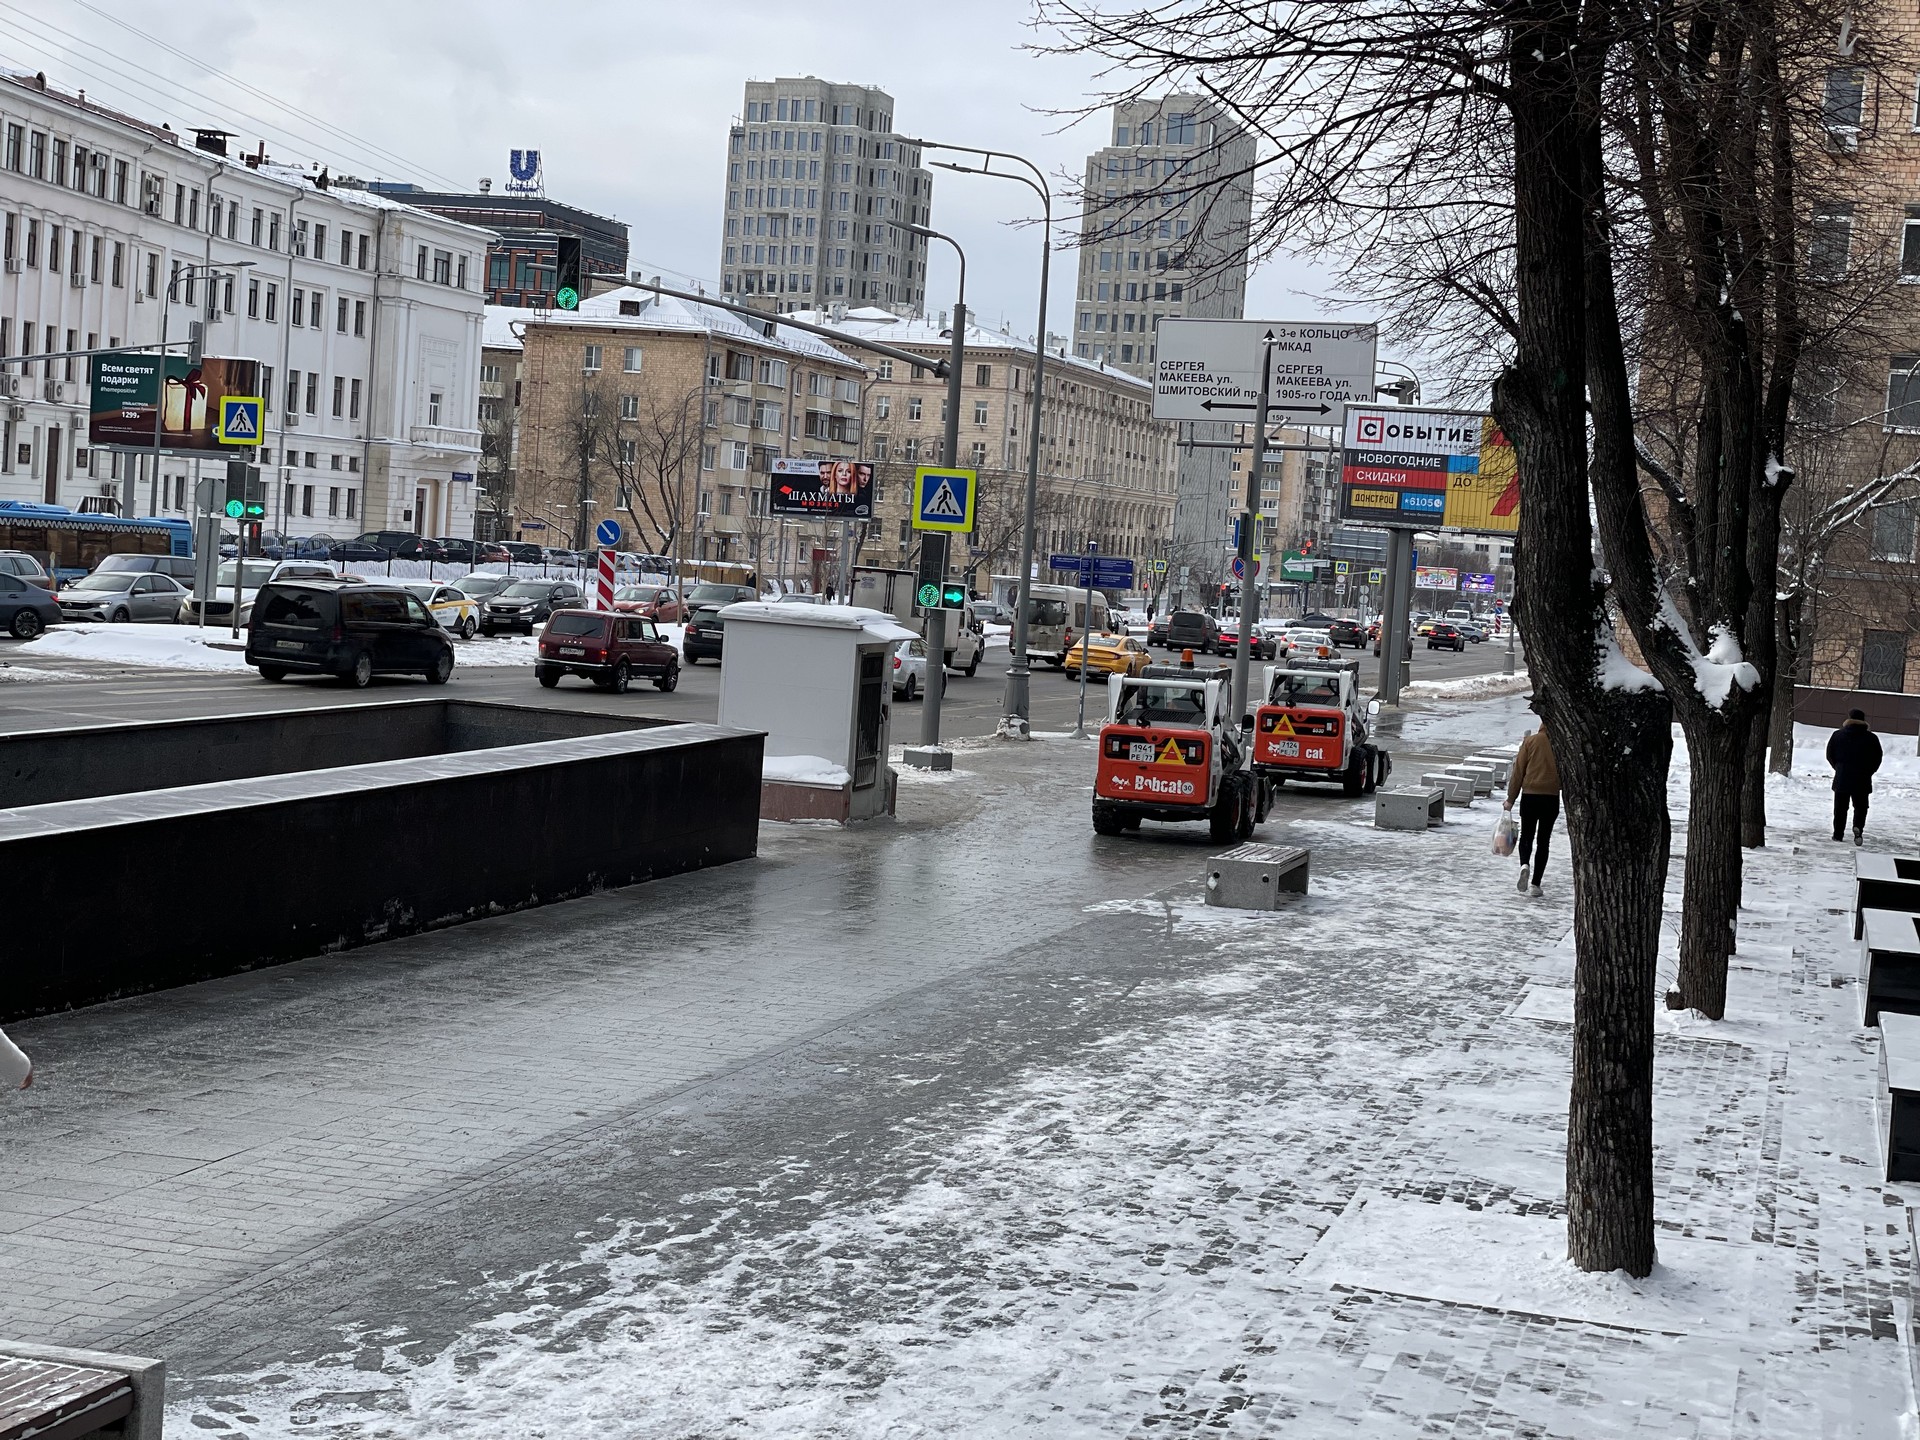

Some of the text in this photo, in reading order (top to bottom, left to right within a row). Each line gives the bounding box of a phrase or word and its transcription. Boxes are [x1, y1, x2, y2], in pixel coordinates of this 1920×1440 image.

[1280, 328, 1349, 341] 3-е КОЛЬЦО
[1278, 342, 1312, 354] МКАД
[101, 363, 154, 375] Всем светят
[1160, 361, 1205, 371] СЕРГЕЯ
[1277, 364, 1323, 375] СЕРГЕЯ
[101, 375, 139, 386] подарки
[1159, 372, 1233, 386] МАКЕЕВА ул.
[1276, 376, 1352, 390] МАКЕЕВА ул.
[1158, 385, 1241, 397] ШМИТОВСКИЙ
[1275, 389, 1371, 402] 1905-го ГОДА ул.
[1358, 452, 1441, 468] НОВОГОДНИЕ
[1356, 470, 1407, 483] СКИДКИ
[1453, 476, 1472, 488] ДО
[788, 491, 855, 503] ШАХМАТЫ
[1355, 493, 1394, 505] ДОНСТРОЙ
[1133, 743, 1153, 753] 1941
[1281, 741, 1298, 749] 7124
[1134, 774, 1182, 795] Bobcat
